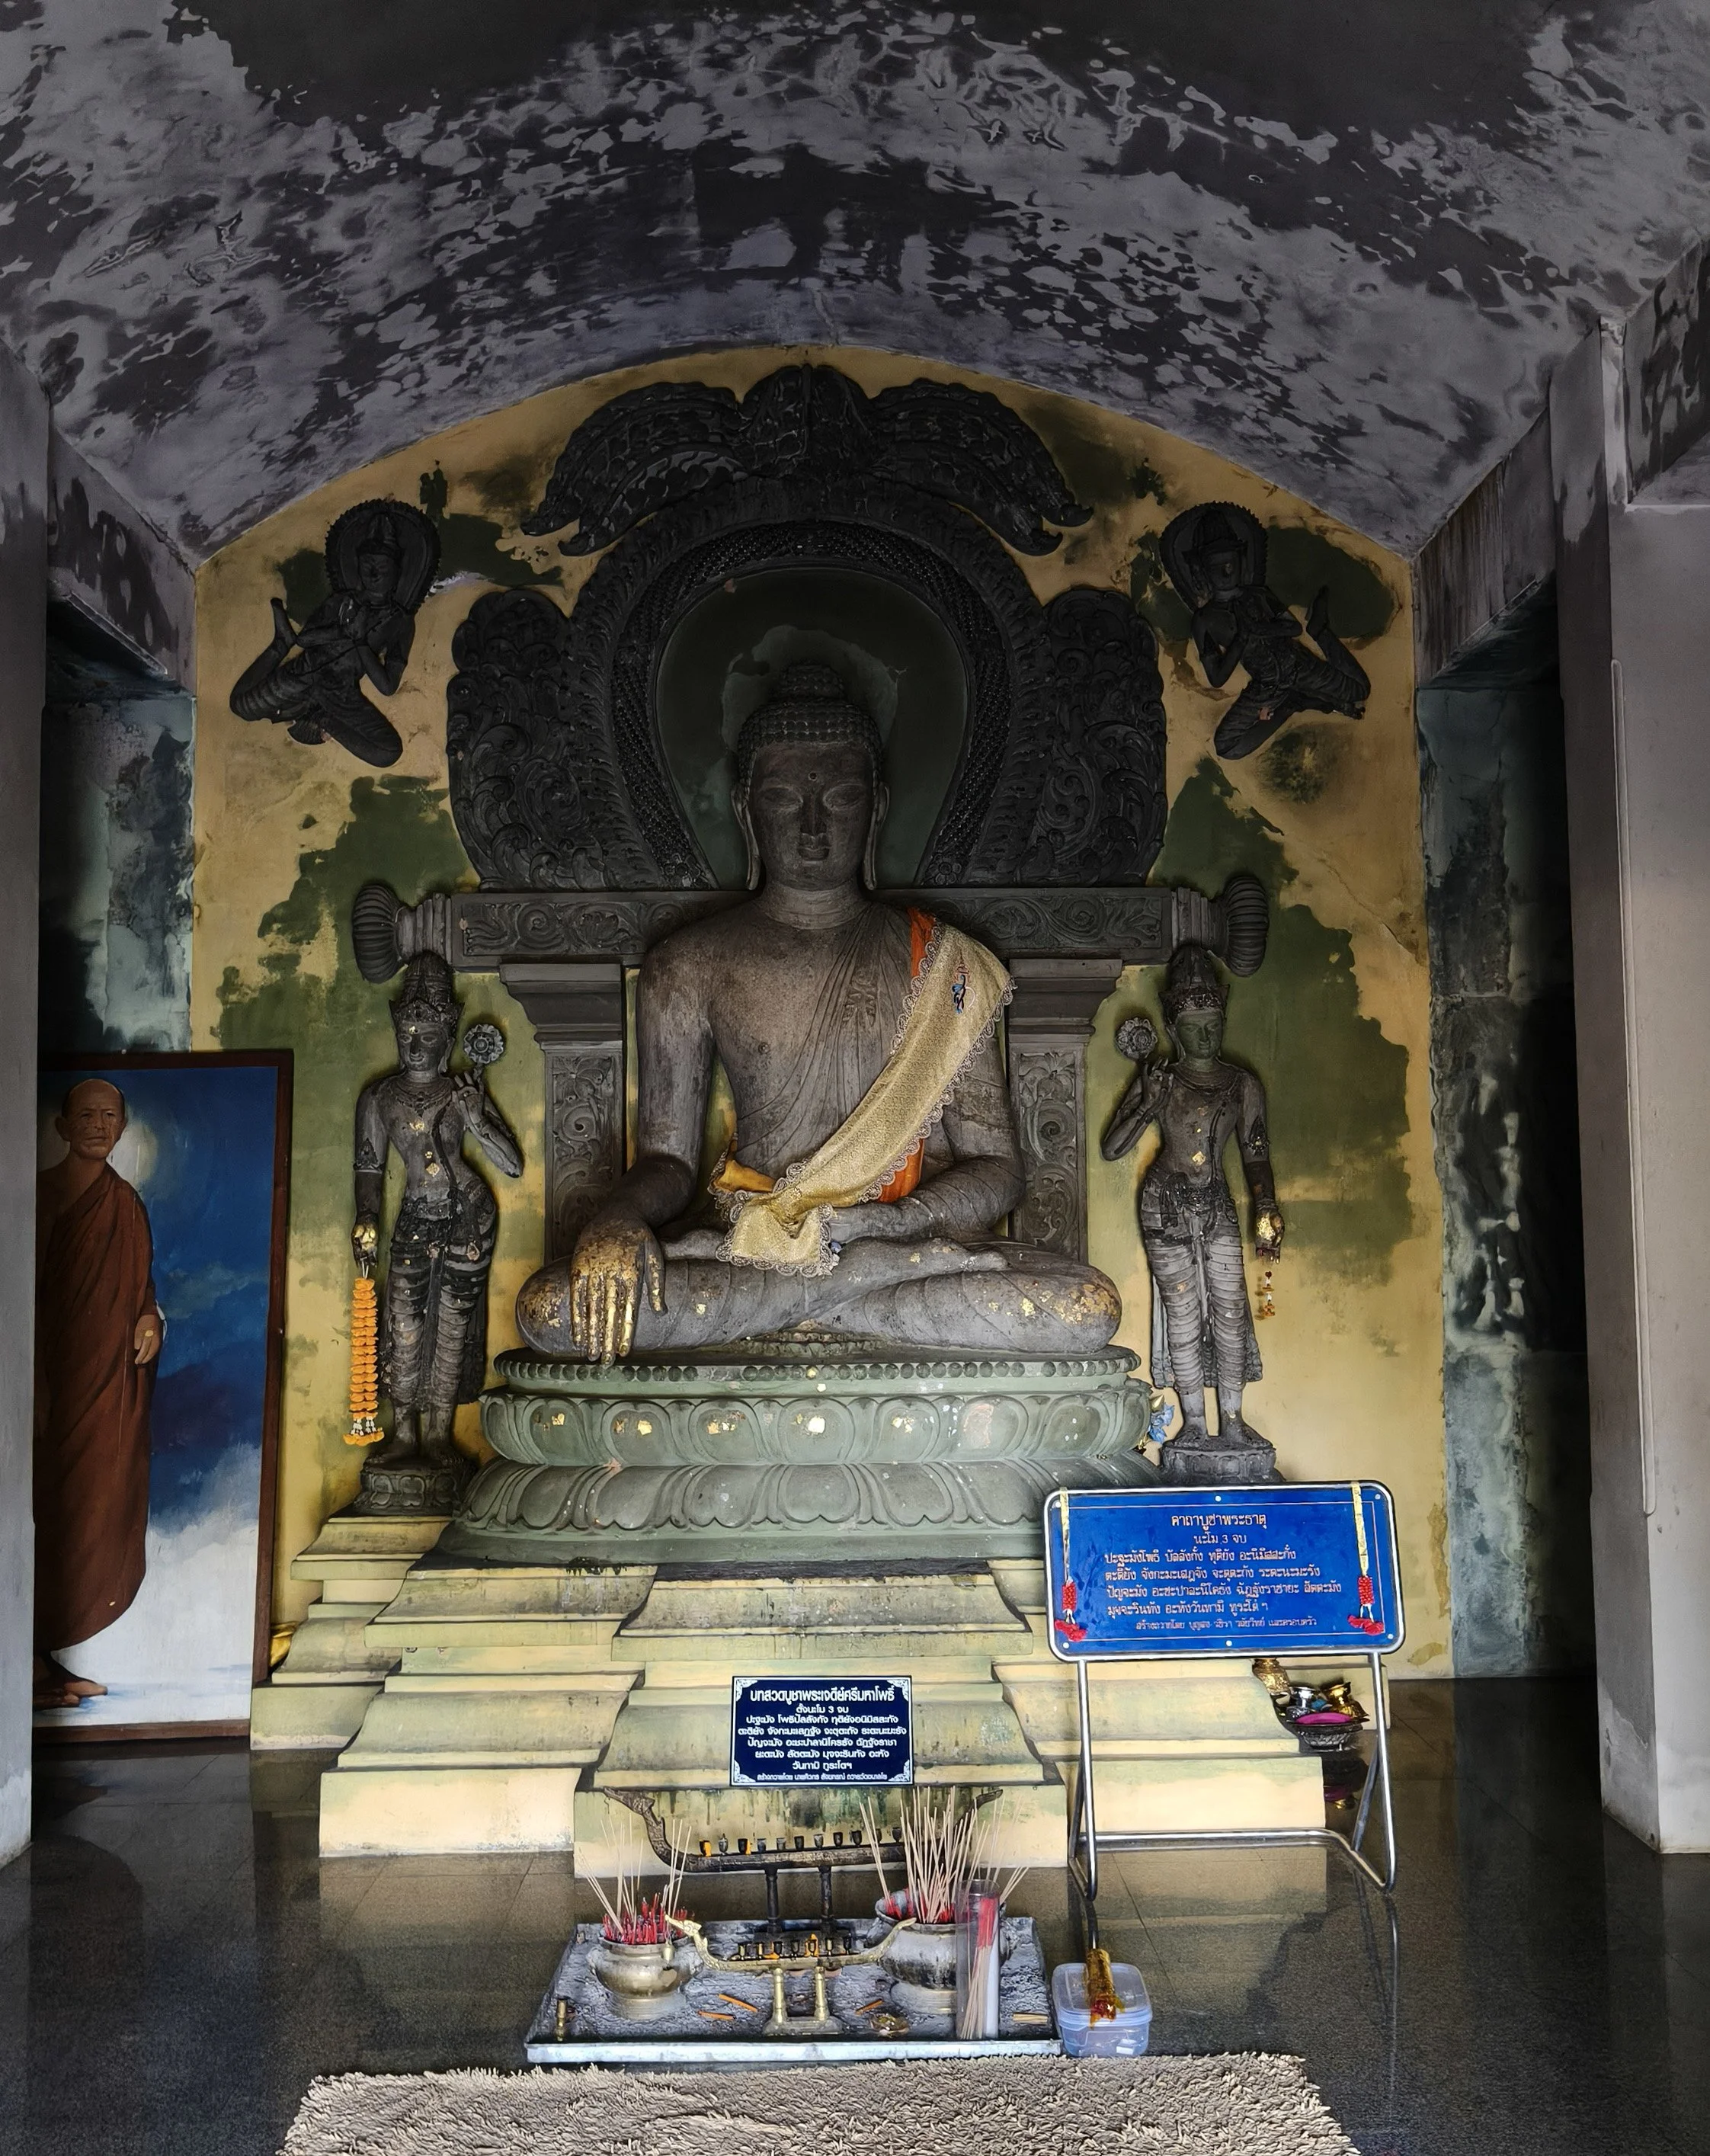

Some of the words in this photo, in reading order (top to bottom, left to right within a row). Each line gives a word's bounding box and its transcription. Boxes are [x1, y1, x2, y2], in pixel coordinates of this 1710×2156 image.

[1172, 1514, 1266, 1530] คาถาบูชาพระธาตุ
[1194, 1532, 1218, 1544] นะโม
[1222, 1534, 1228, 1543] 3
[1233, 1534, 1247, 1543] จบ
[751, 1685, 895, 1705] บทสวดบูชาพระเจดีย์ศรีมหาโพธิ์
[796, 1703, 825, 1713] ตั้งนะโม
